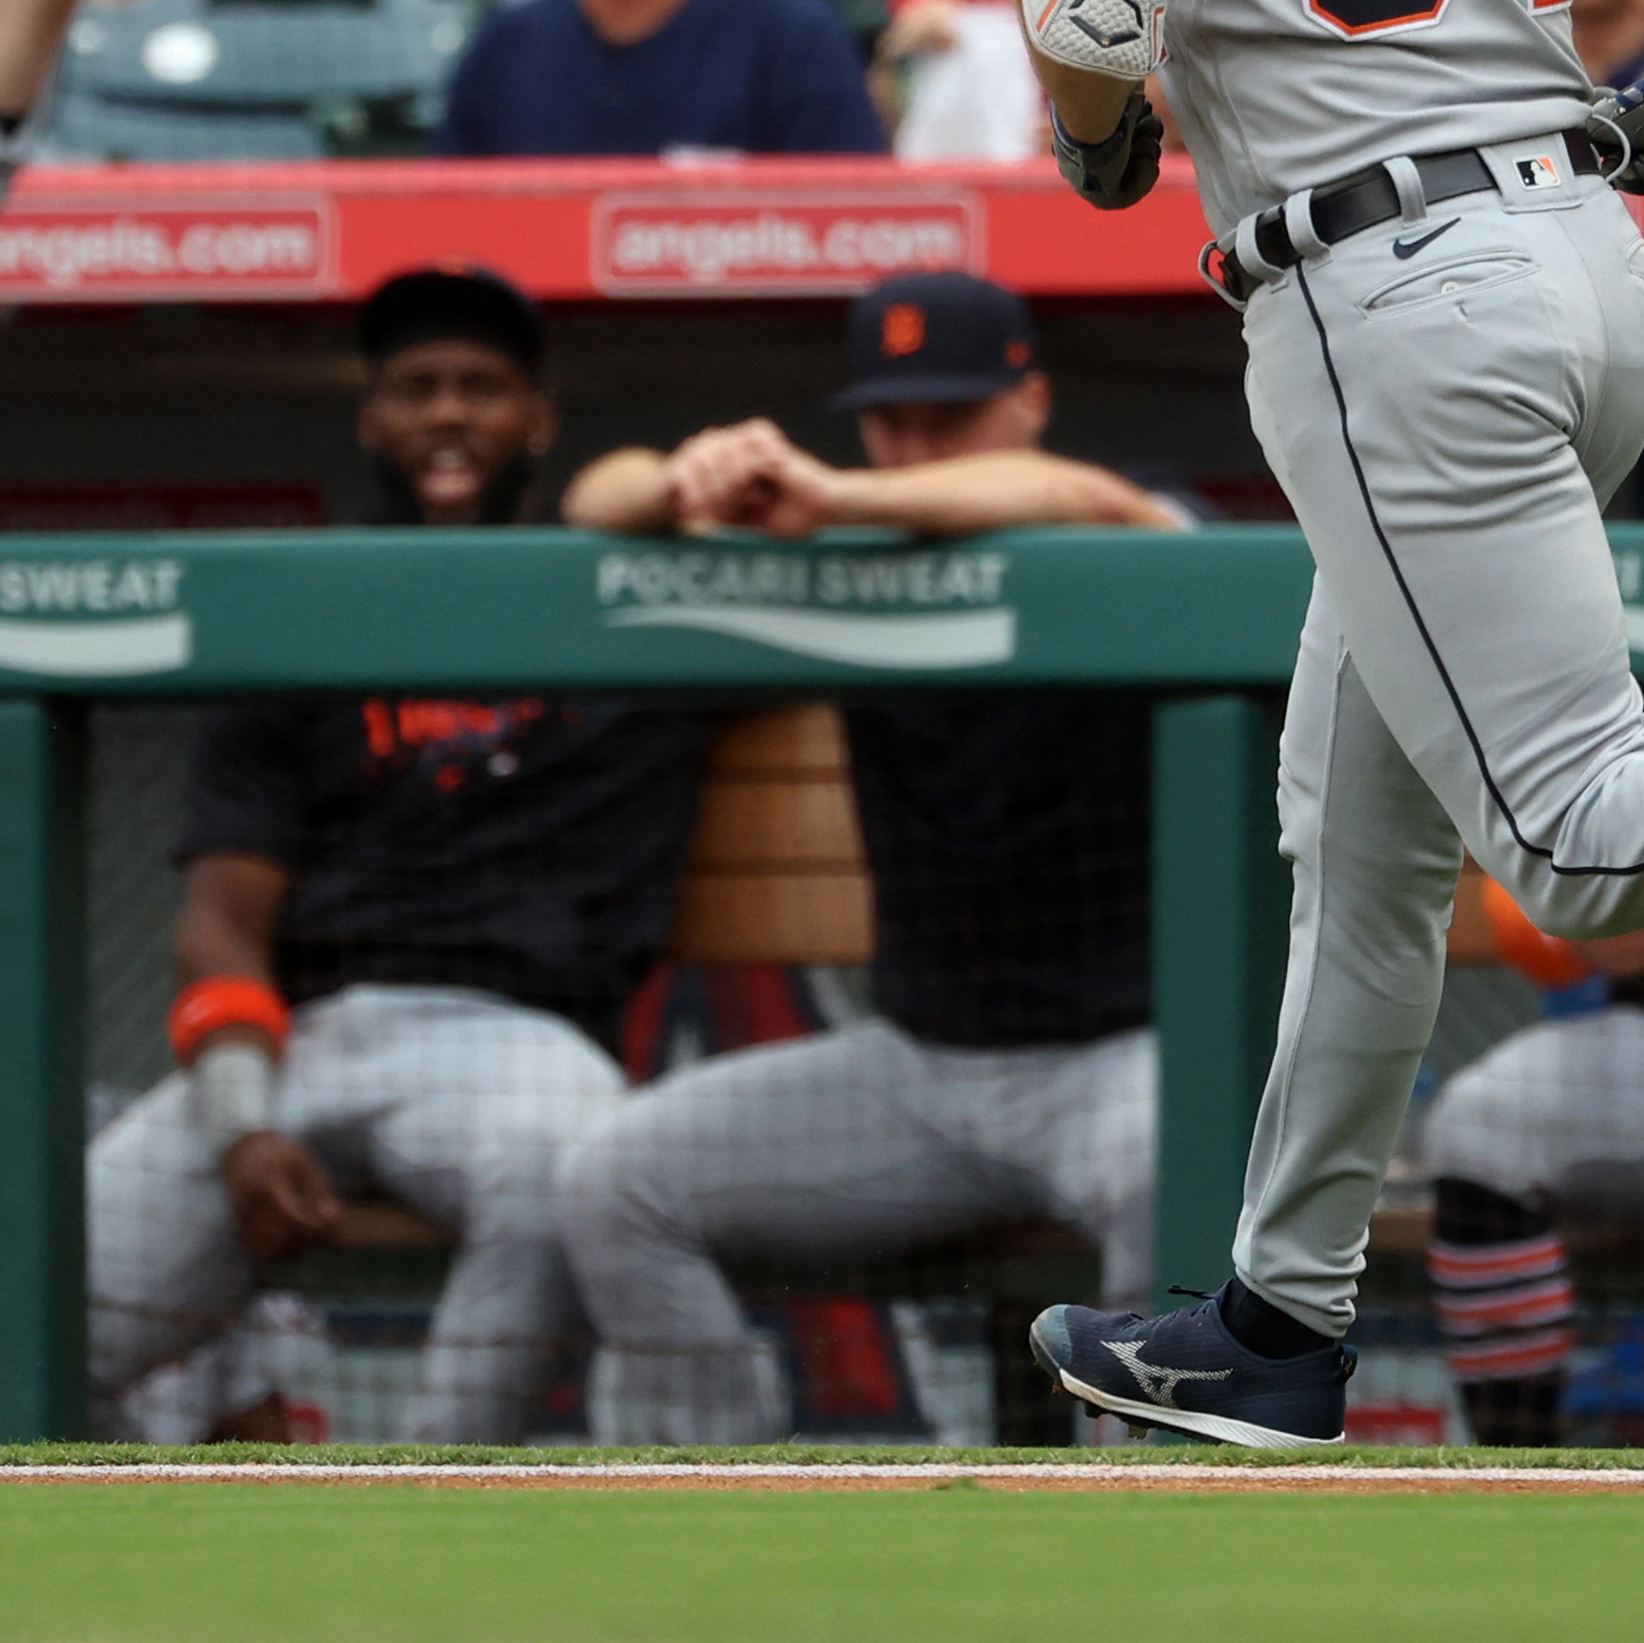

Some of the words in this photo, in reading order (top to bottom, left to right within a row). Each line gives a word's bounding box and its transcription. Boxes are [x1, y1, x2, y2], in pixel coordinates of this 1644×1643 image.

[614, 214, 959, 283] angels.com
[596, 552, 809, 605] POCARI
[816, 553, 1008, 605] SWEAT
